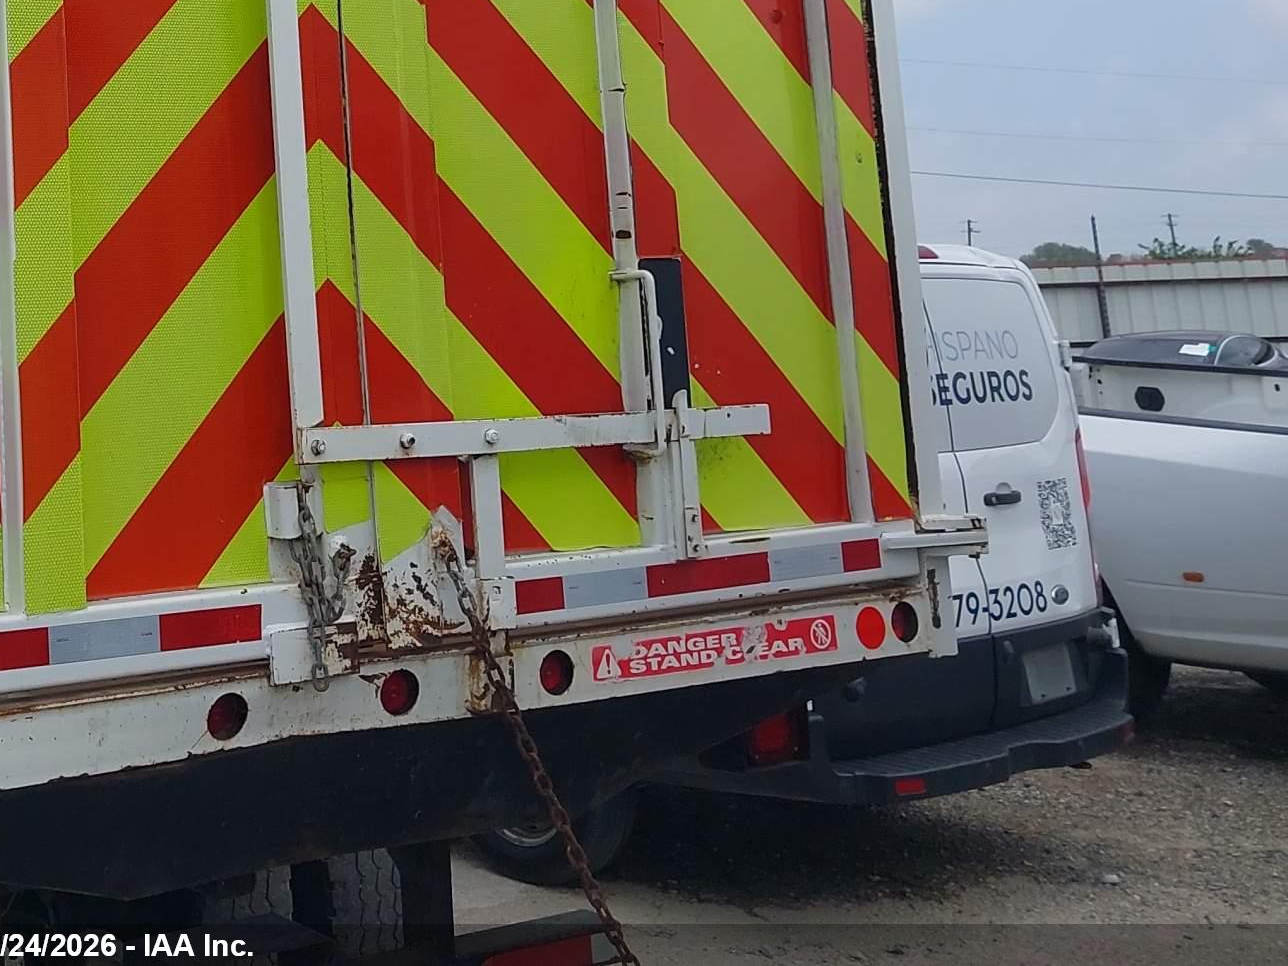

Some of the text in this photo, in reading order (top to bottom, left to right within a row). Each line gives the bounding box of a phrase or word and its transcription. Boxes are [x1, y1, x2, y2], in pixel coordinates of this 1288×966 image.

[629, 637, 805, 674] STAND CEAR
[630, 633, 738, 660] DANGER
